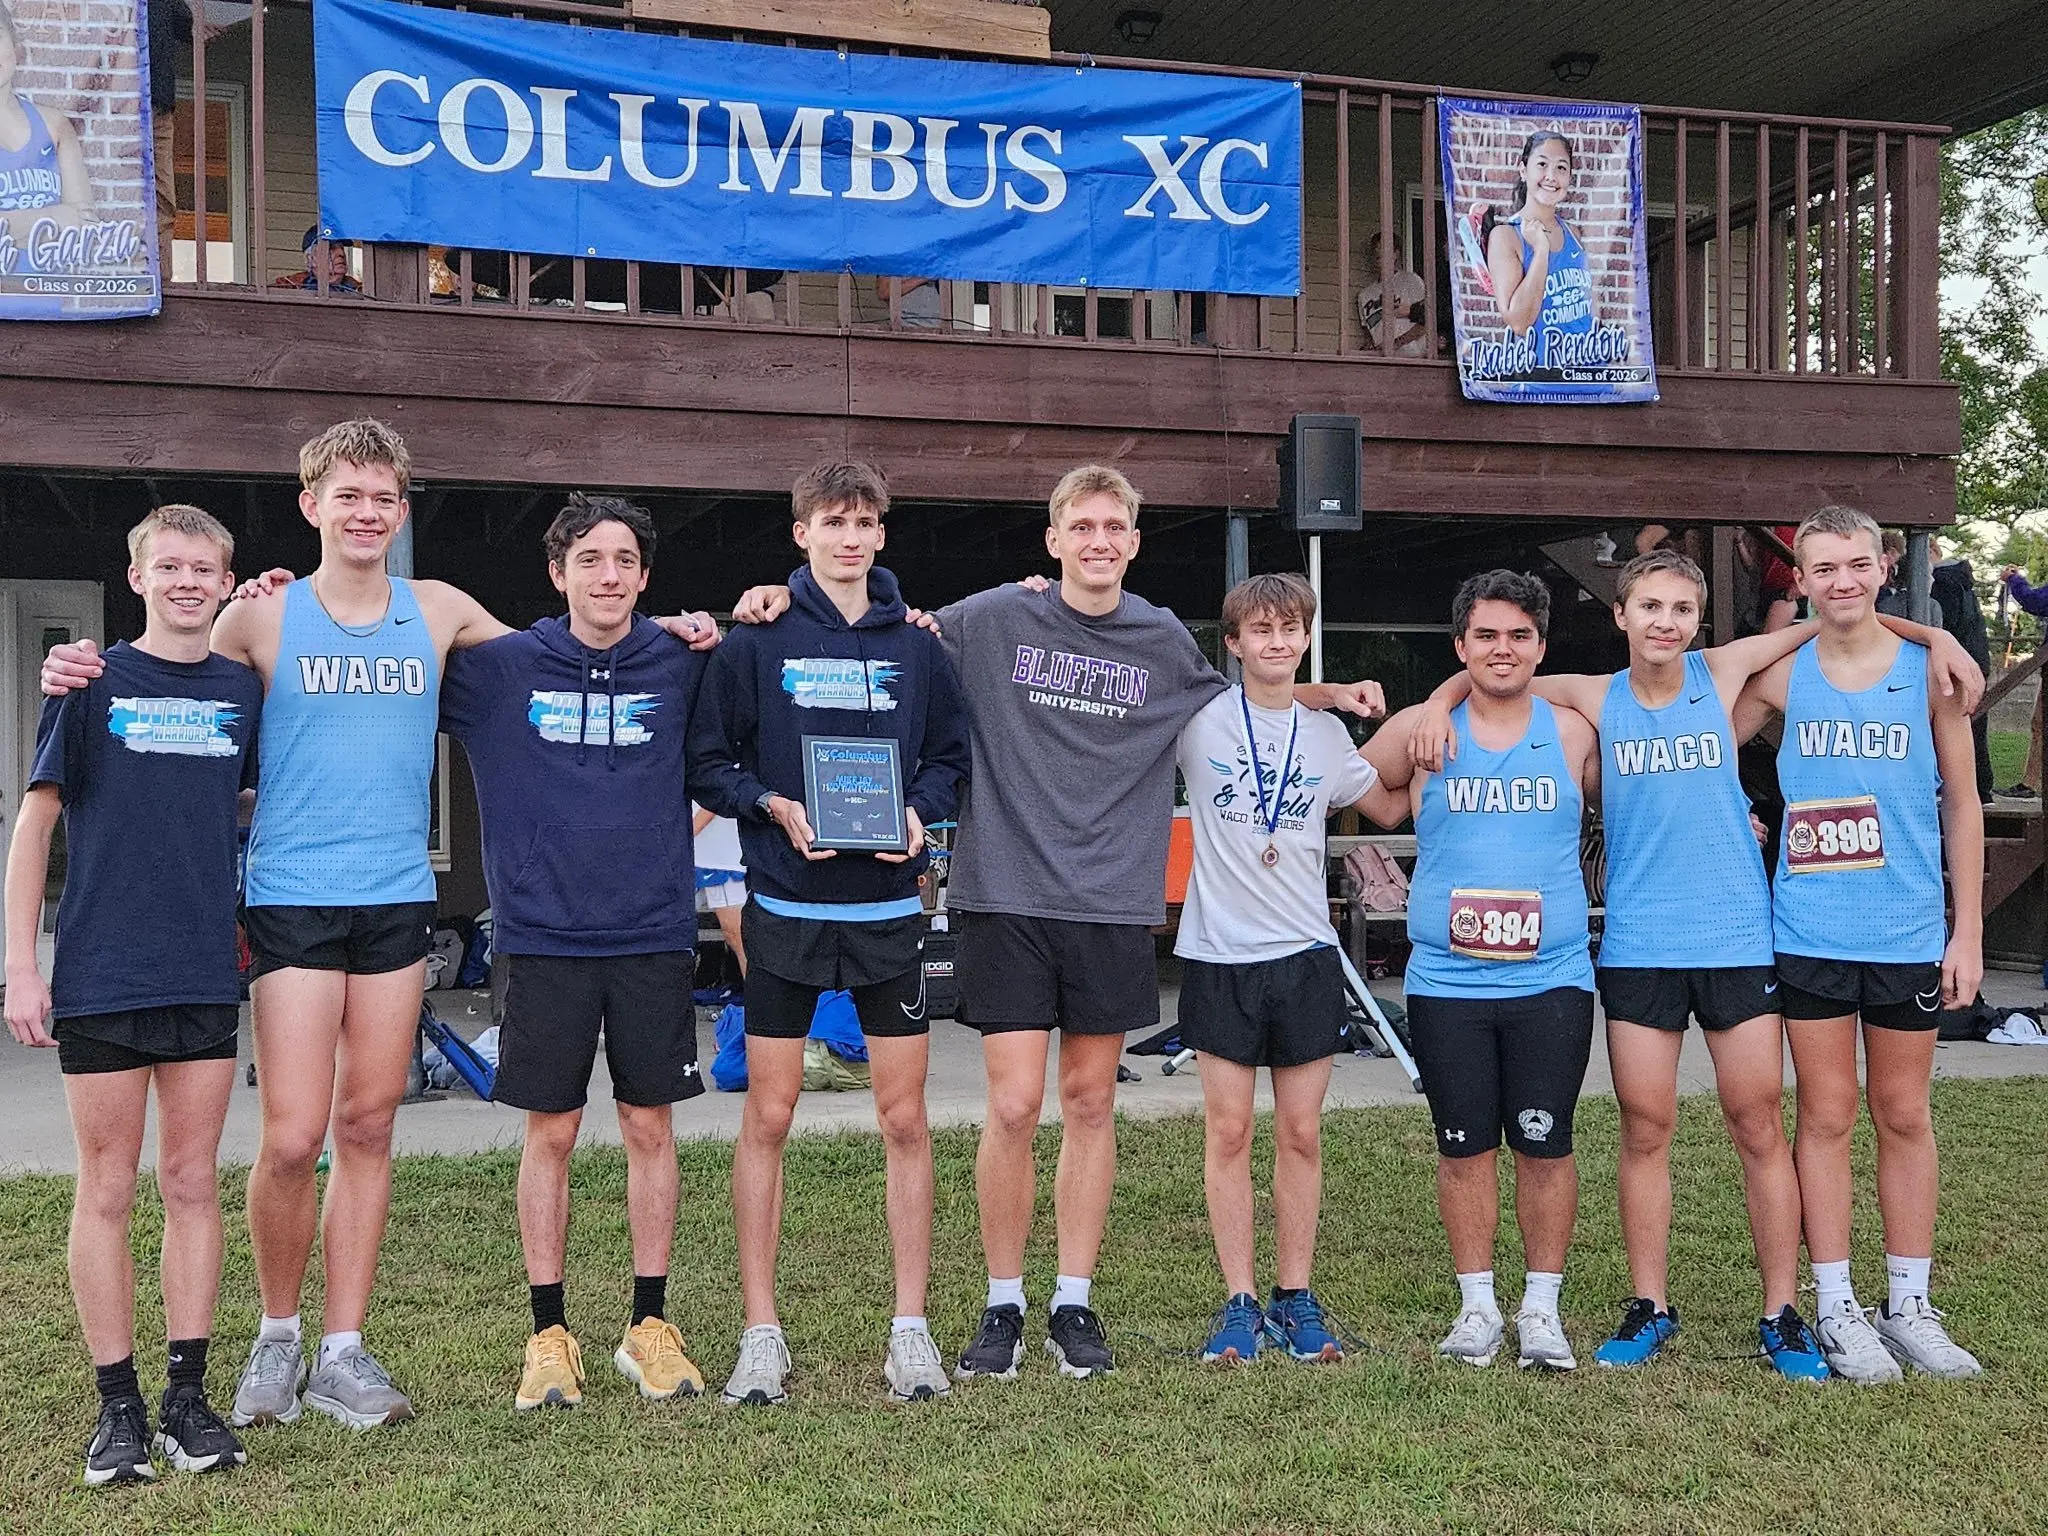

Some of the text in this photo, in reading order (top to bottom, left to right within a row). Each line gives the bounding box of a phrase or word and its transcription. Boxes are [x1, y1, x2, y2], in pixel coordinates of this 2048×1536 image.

[344, 70, 1269, 225] COLUMBUS XC
[28, 217, 140, 273] Garza
[24, 278, 138, 293] Class of 2026
[1543, 299, 1592, 326] COMMUNITY
[1543, 317, 1629, 371] Rendon
[1562, 369, 1639, 381] Class of 2026
[298, 656, 426, 695] WACO
[818, 684, 865, 697] WARRIORS
[1012, 644, 1149, 707] BLUFFTON
[137, 700, 216, 726] WACO
[1029, 690, 1128, 719] UNIVERSITY
[154, 727, 207, 741] WARRIORS
[1797, 720, 1911, 760] WACO
[830, 749, 889, 761] Columbus
[1613, 732, 1722, 776] WACO
[1213, 783, 1239, 807] &
[1445, 775, 1557, 813] WACO
[1220, 809, 1305, 831] WACO WARIORS
[1818, 817, 1880, 856] 396
[1482, 910, 1540, 946] 394
